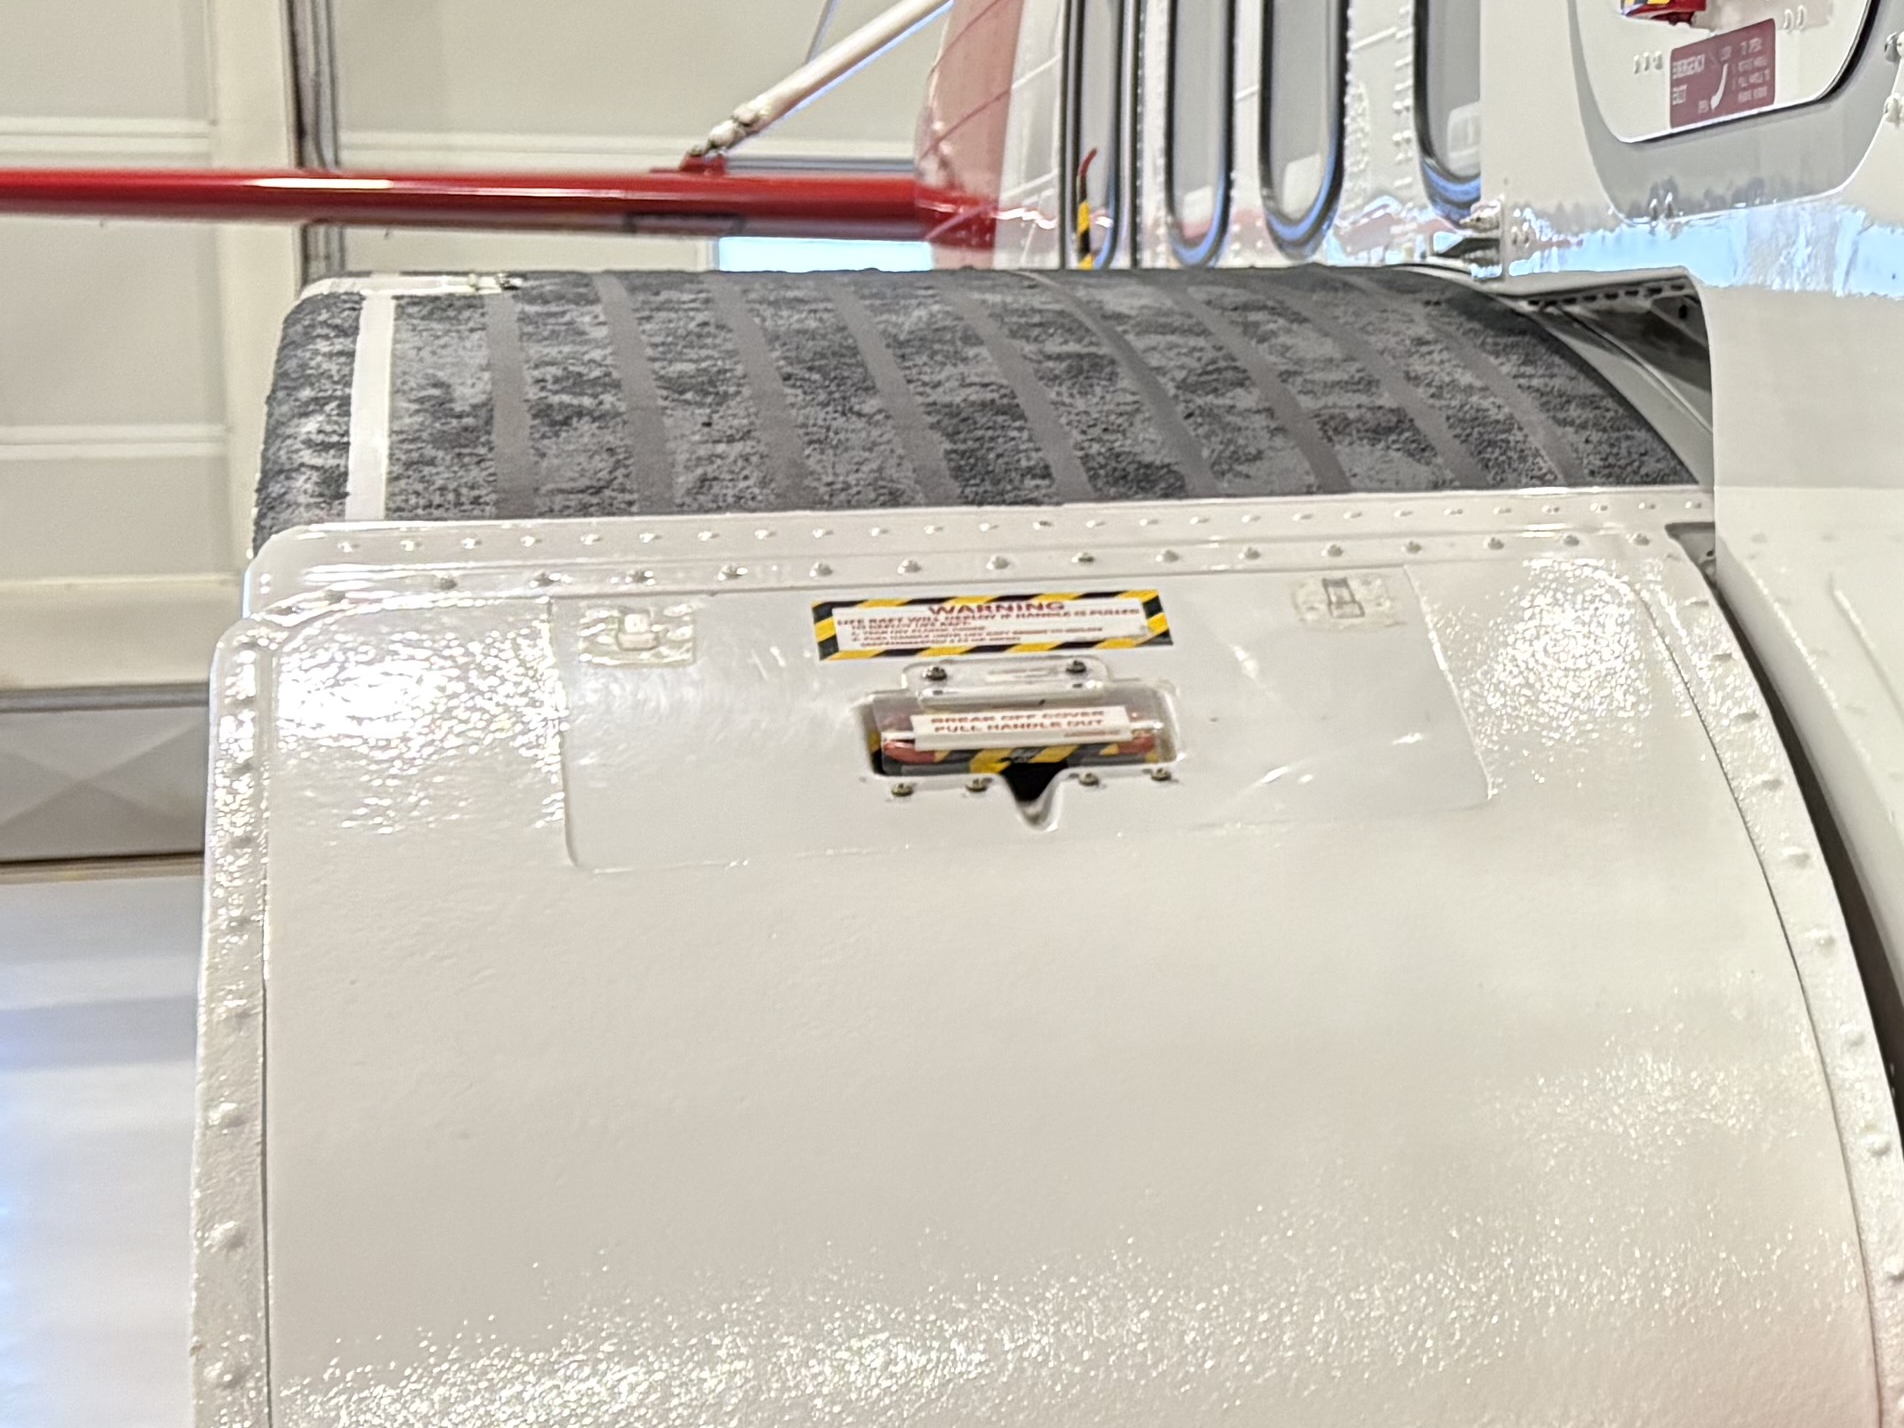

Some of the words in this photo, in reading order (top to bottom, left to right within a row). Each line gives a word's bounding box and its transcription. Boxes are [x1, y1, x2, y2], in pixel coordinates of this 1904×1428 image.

[929, 600, 1065, 616] WARNING
[837, 618, 864, 626] LIFE
[869, 616, 903, 625] RAFT
[908, 615, 940, 623] WILL
[1015, 610, 1071, 619] HANDLE
[1089, 607, 1140, 617] PULLED
[931, 714, 996, 724] BREAK
[1001, 713, 1037, 722] OFF
[1042, 709, 1105, 720] COVER
[934, 724, 983, 733] PULL
[987, 721, 1061, 732] HANDLE
[1067, 719, 1105, 729] OUT
